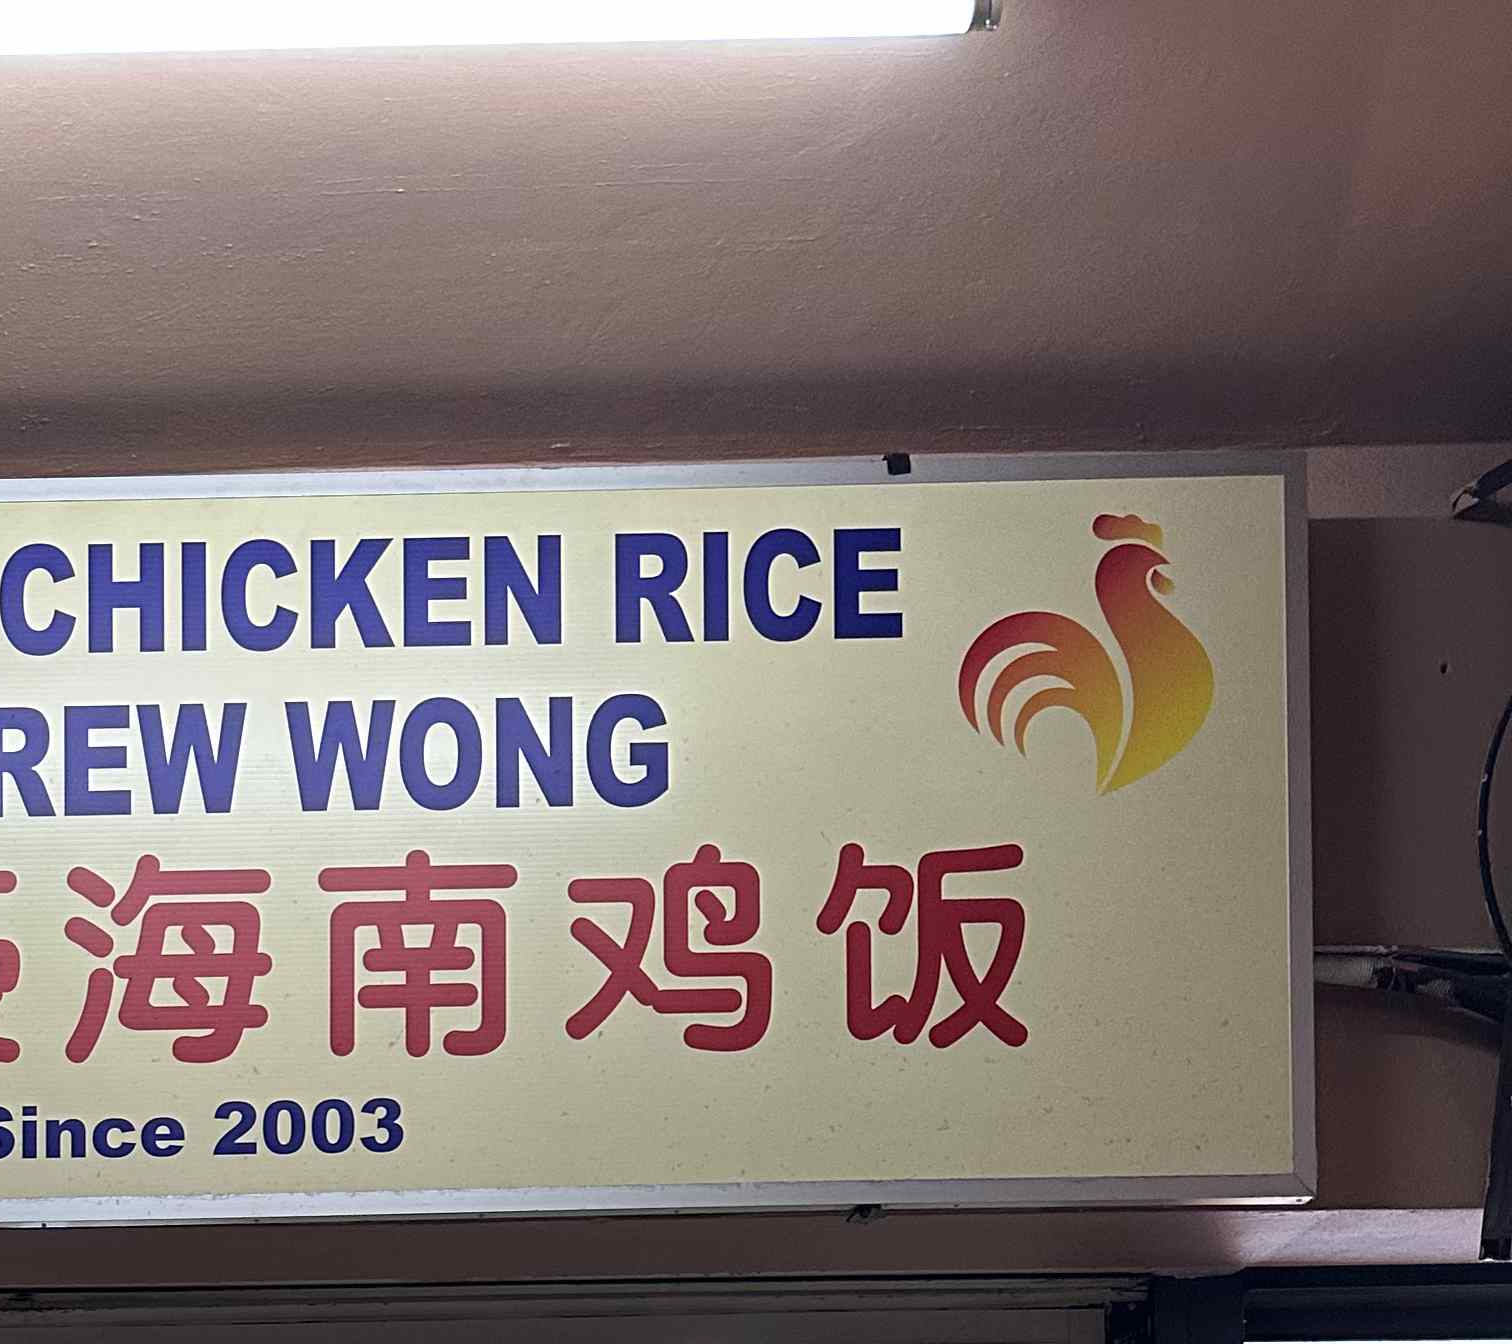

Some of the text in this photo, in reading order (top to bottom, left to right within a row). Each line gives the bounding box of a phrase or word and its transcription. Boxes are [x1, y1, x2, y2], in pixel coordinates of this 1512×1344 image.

[615, 528, 903, 642] RICE
[286, 694, 670, 812] WONG
[215, 1099, 404, 1156] 2003
